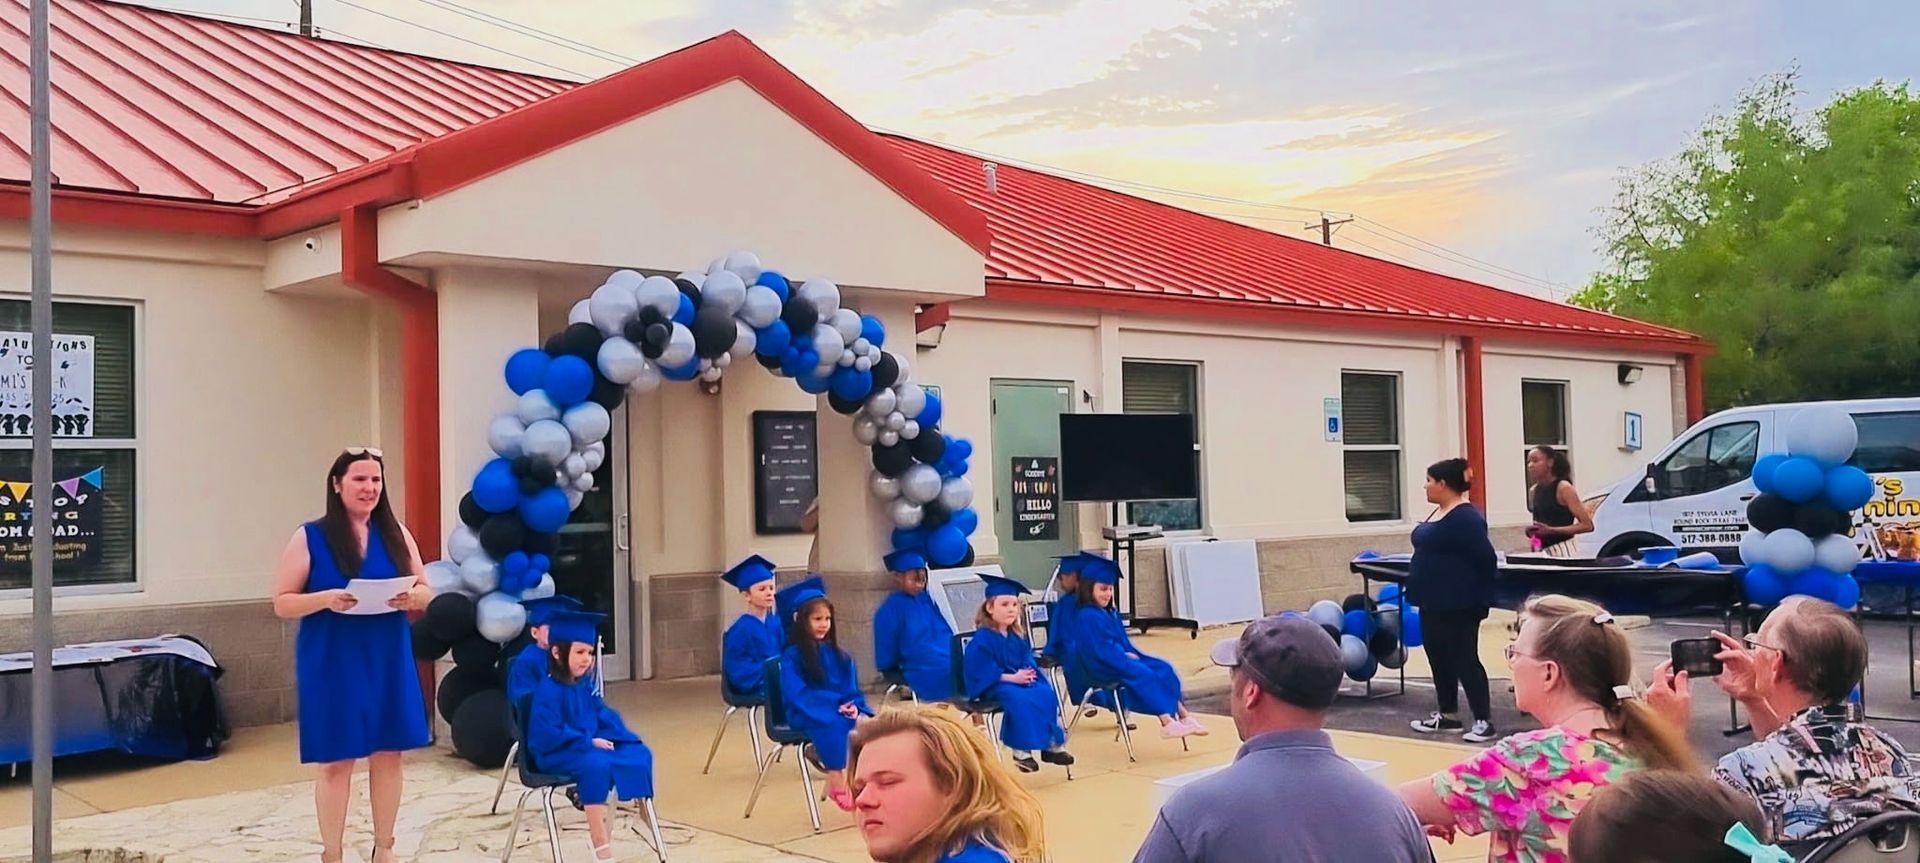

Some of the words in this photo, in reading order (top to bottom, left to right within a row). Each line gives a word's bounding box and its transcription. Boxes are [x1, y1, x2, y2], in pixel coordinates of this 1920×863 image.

[17, 354, 34, 365] TO
[1631, 419, 1637, 441] 1
[1026, 499, 1052, 511] HELLO
[51, 524, 95, 537] AD...
